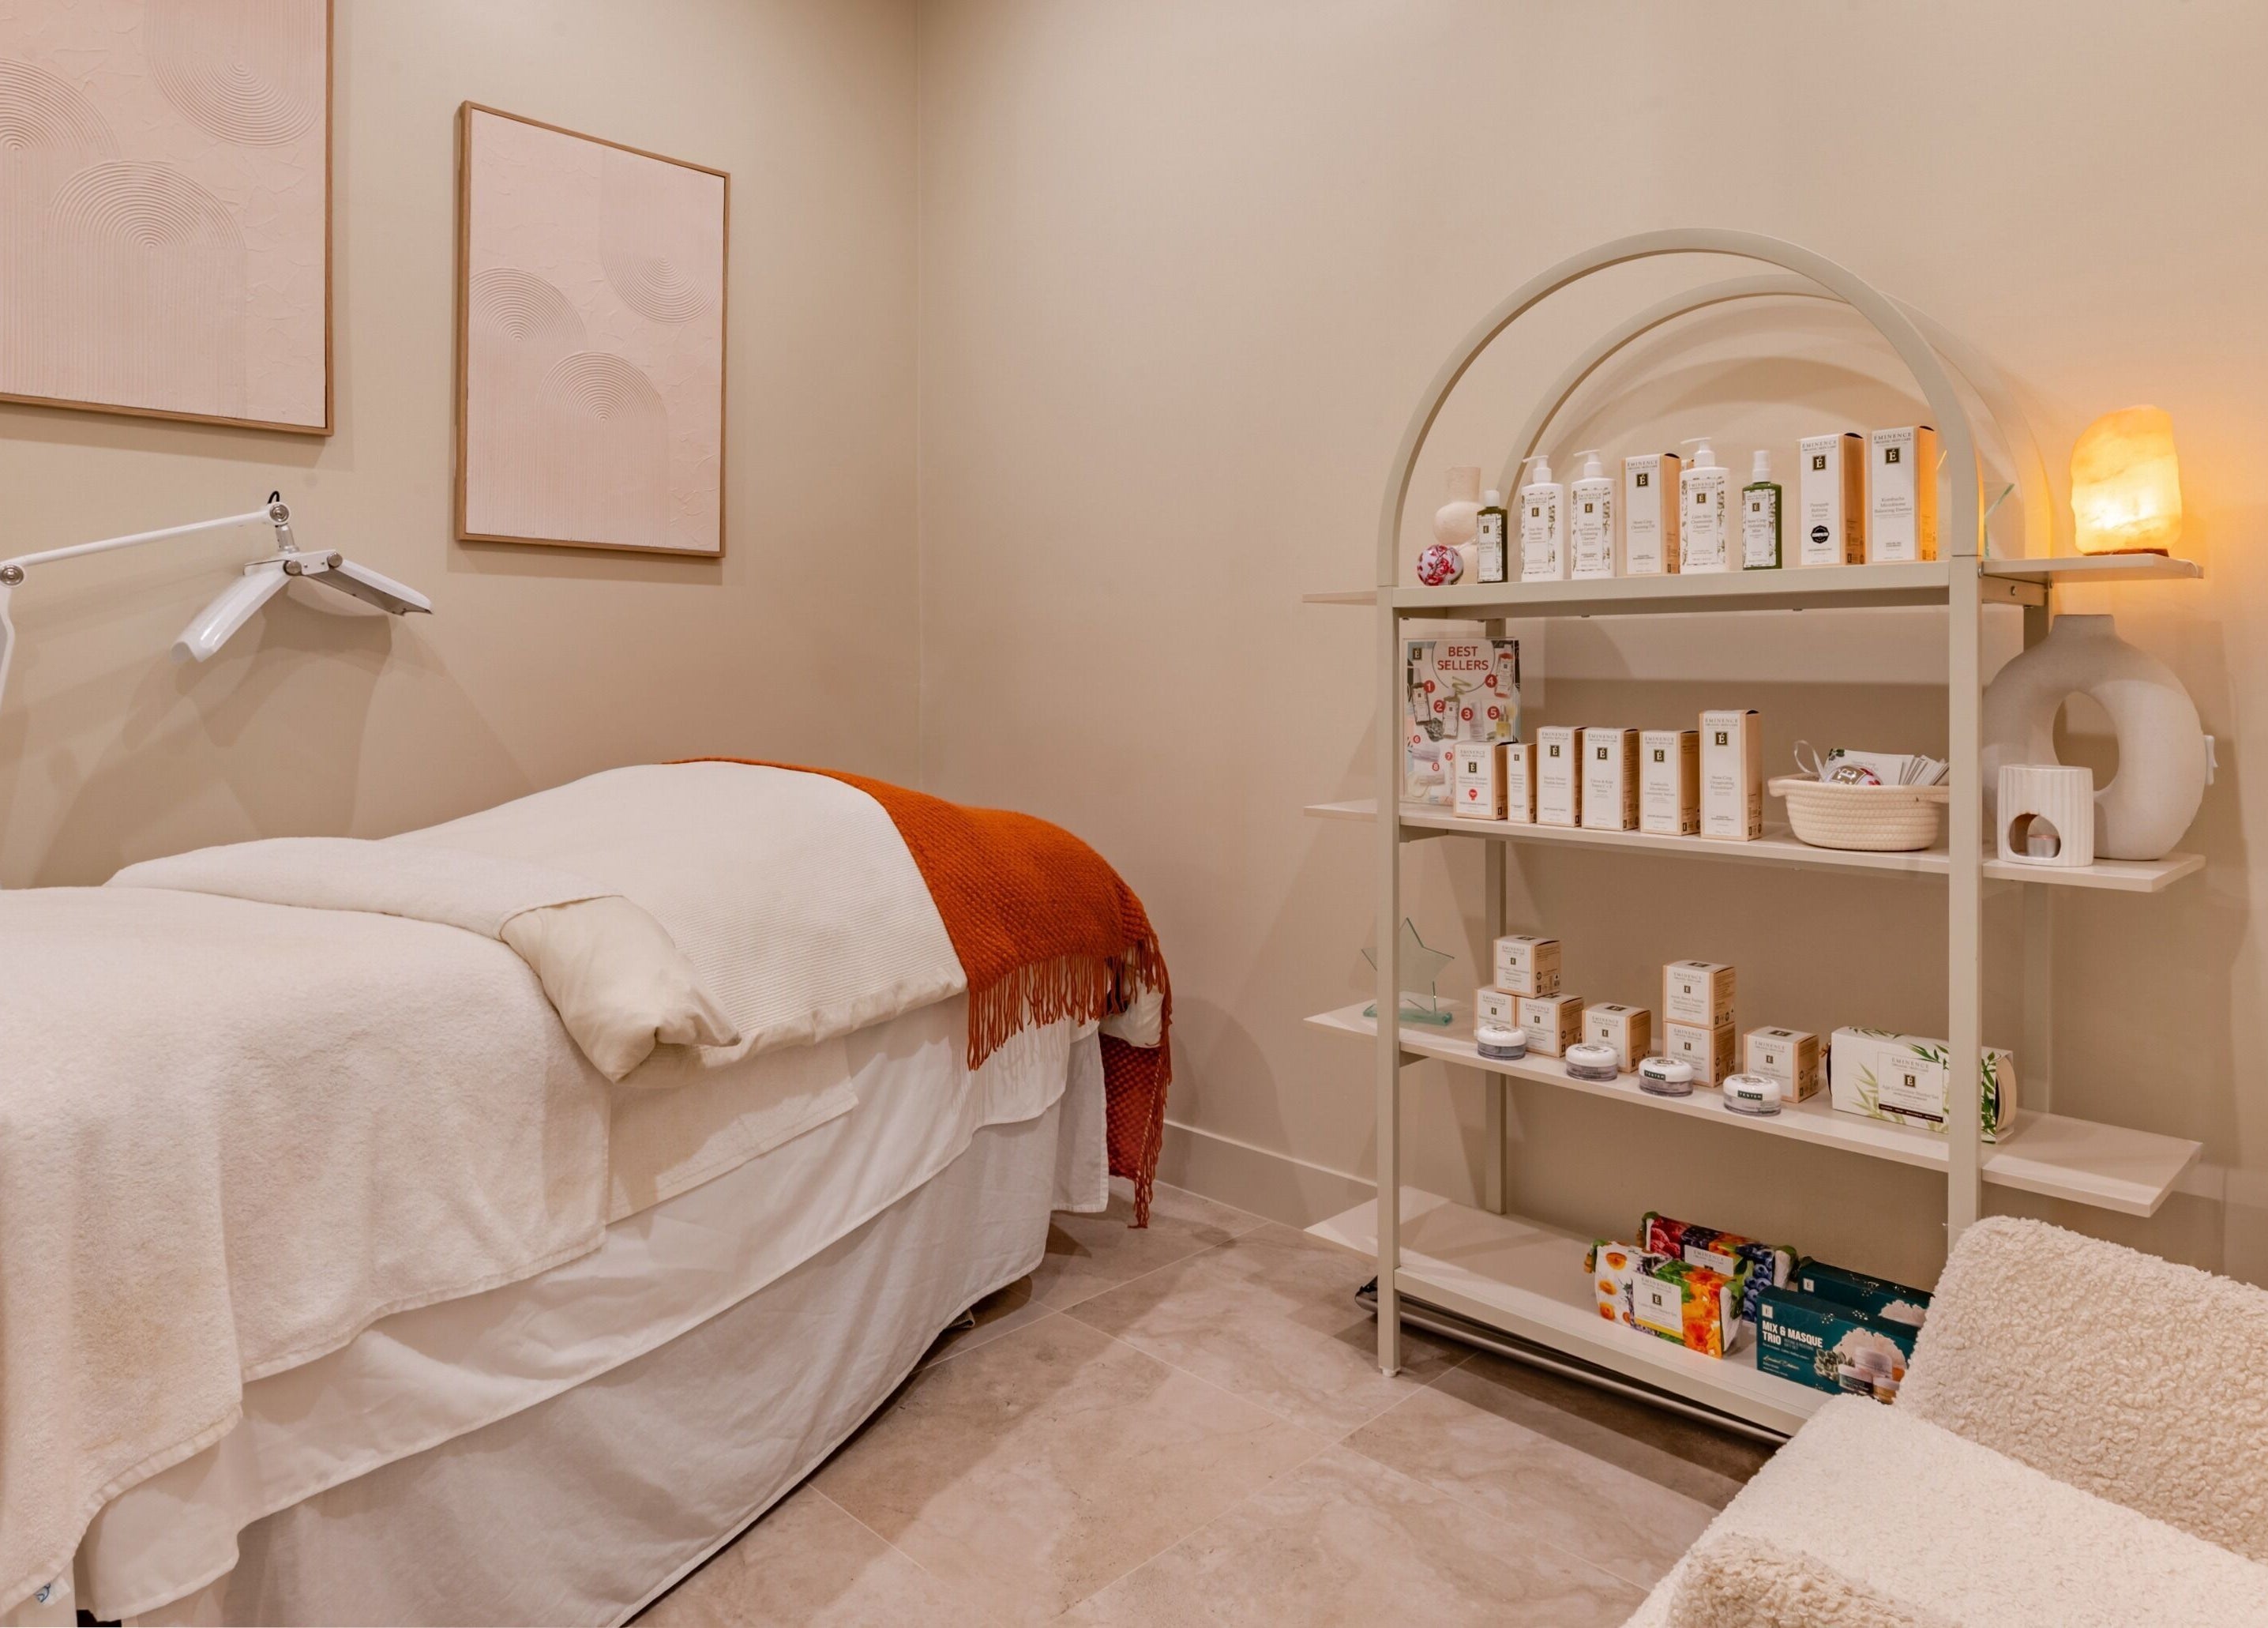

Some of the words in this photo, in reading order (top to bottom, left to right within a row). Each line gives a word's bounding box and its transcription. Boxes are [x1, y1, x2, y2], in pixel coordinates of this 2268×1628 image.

[1448, 646, 1478, 657] BEST
[1437, 660, 1489, 671] SELLERS
[1762, 1320, 1778, 1334] MIX
[1779, 1325, 1785, 1336] &
[1788, 1329, 1823, 1348] MASQUE
[1763, 1331, 1782, 1345] TRIO
